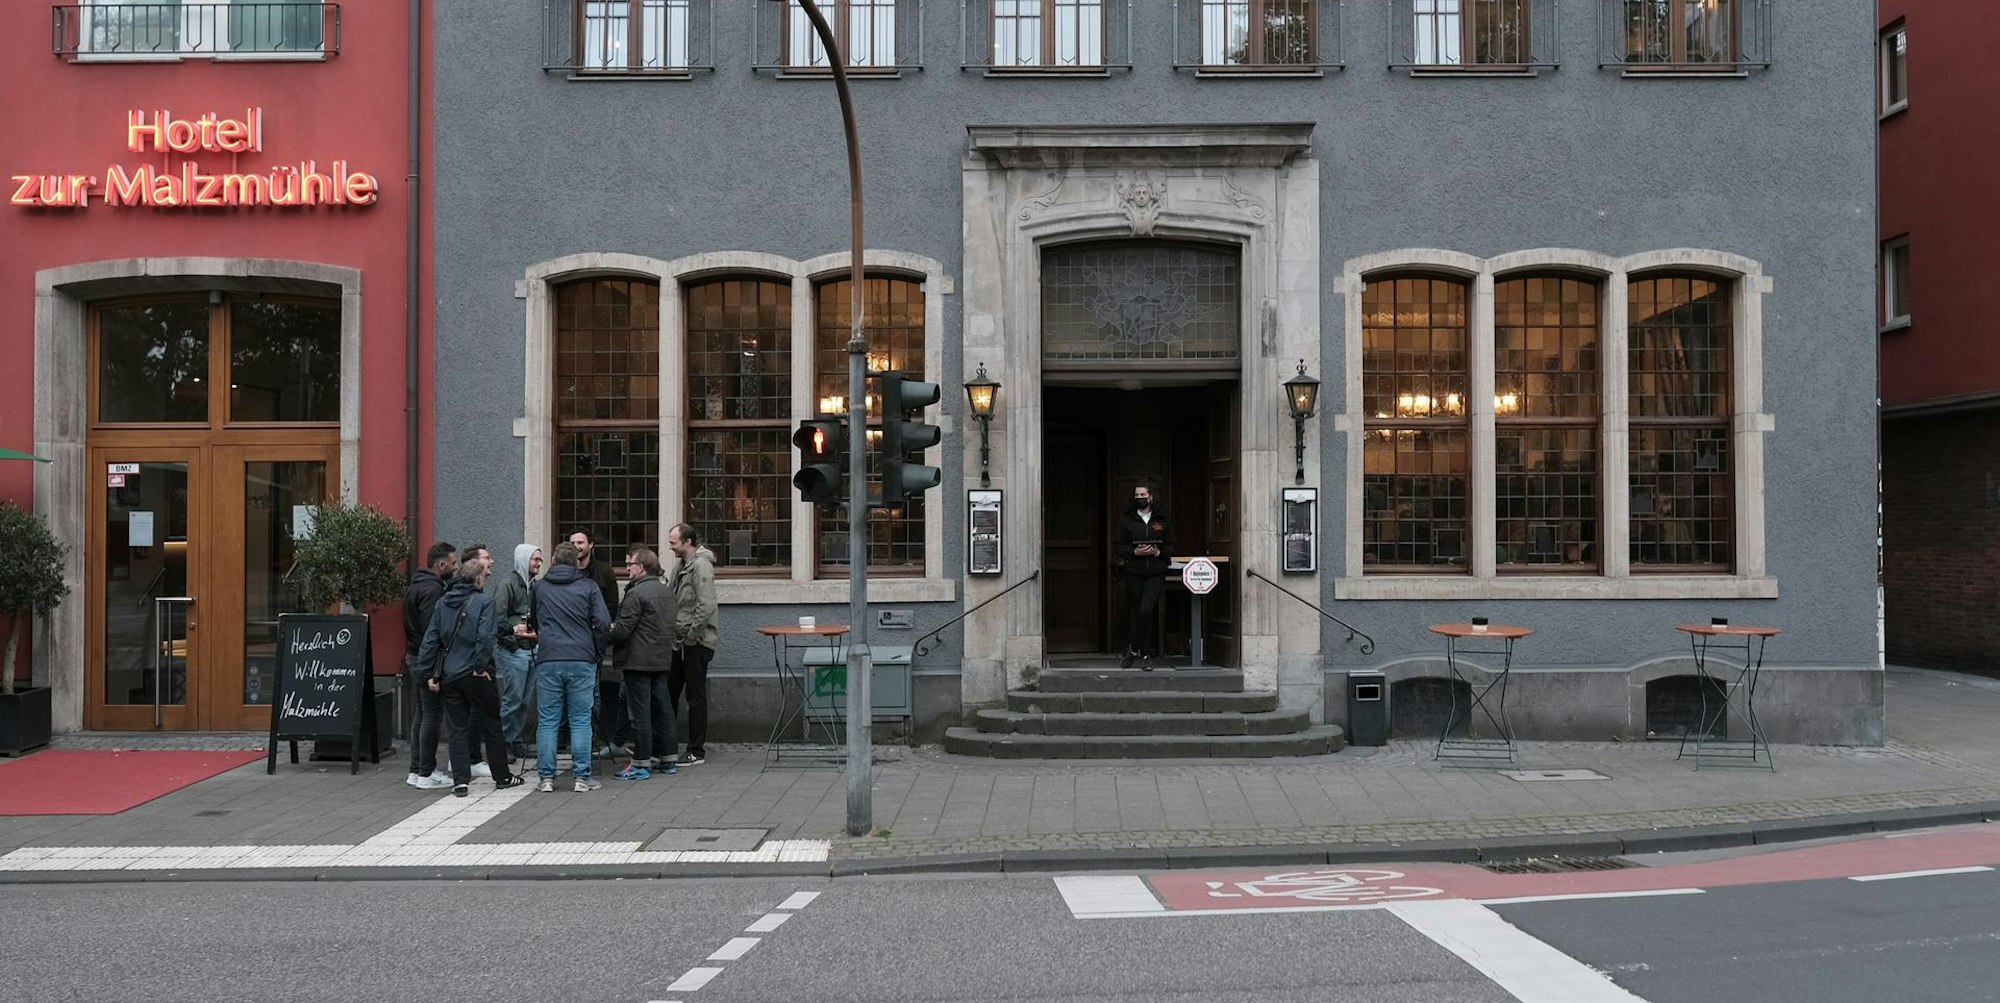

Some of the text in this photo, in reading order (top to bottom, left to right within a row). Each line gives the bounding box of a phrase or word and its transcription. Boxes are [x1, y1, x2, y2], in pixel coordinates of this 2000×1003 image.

[127, 106, 263, 153] Hotel
[11, 159, 379, 208] zur Malzmühle
[291, 628, 335, 654] Herzlich
[295, 660, 356, 680] Willkommen
[315, 679, 346, 692] in der
[280, 691, 340, 719] Malzmühle
